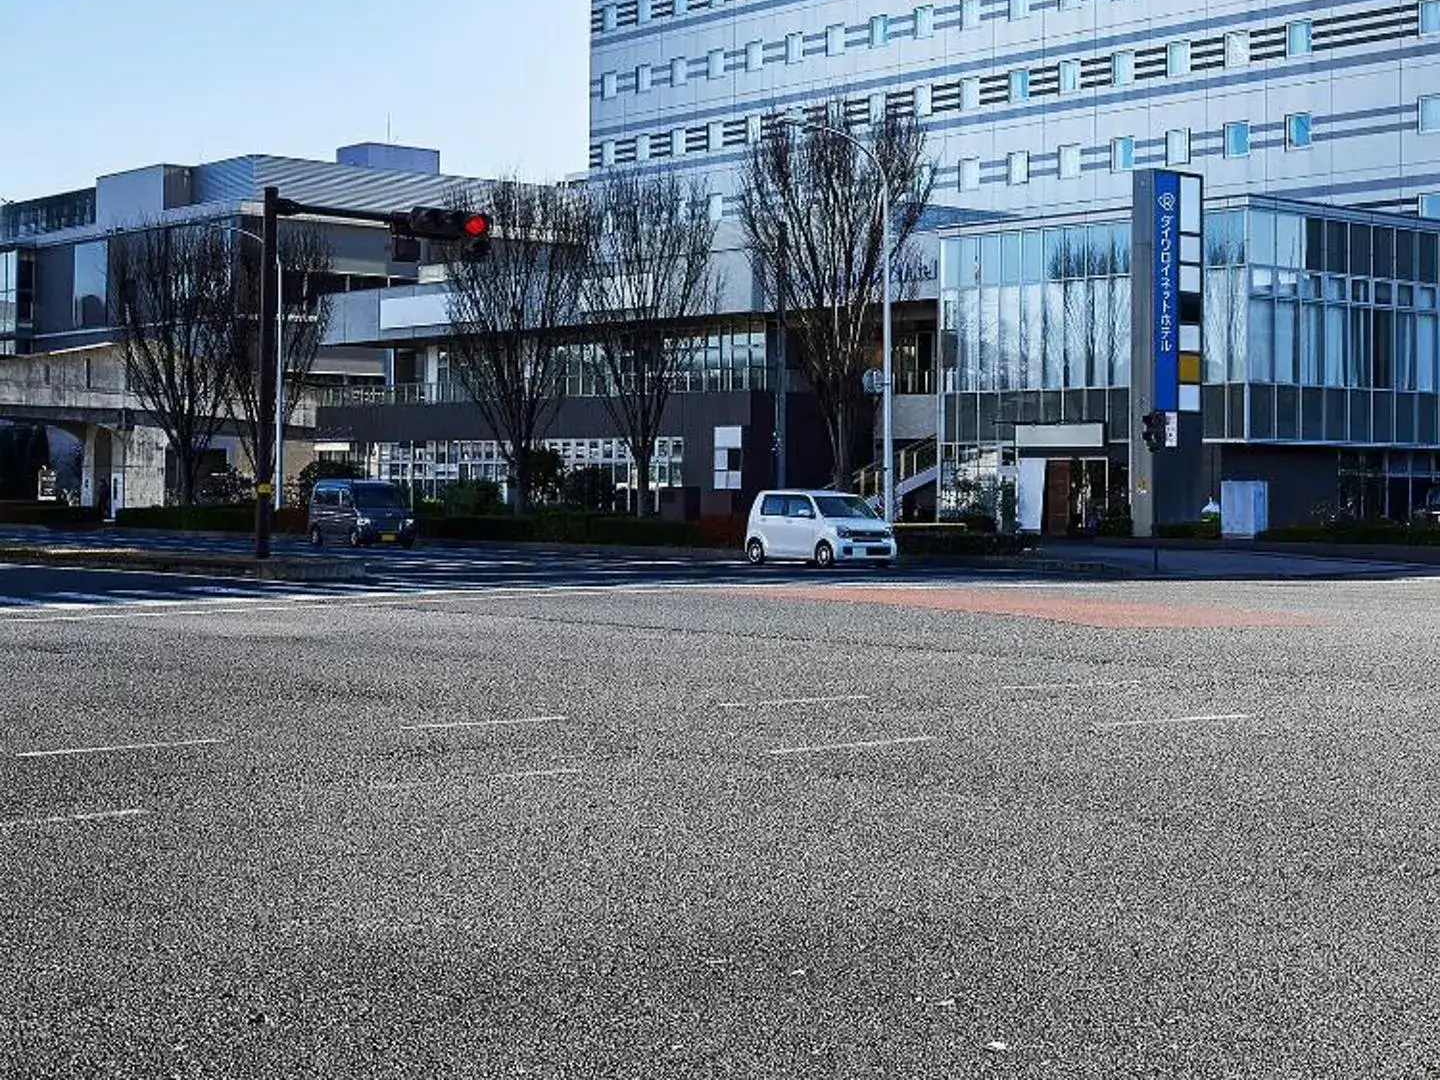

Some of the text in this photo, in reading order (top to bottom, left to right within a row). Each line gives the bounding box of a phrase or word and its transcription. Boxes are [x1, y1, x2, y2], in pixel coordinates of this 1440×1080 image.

[1160, 214, 1173, 353] ダイワロイネットホテル
